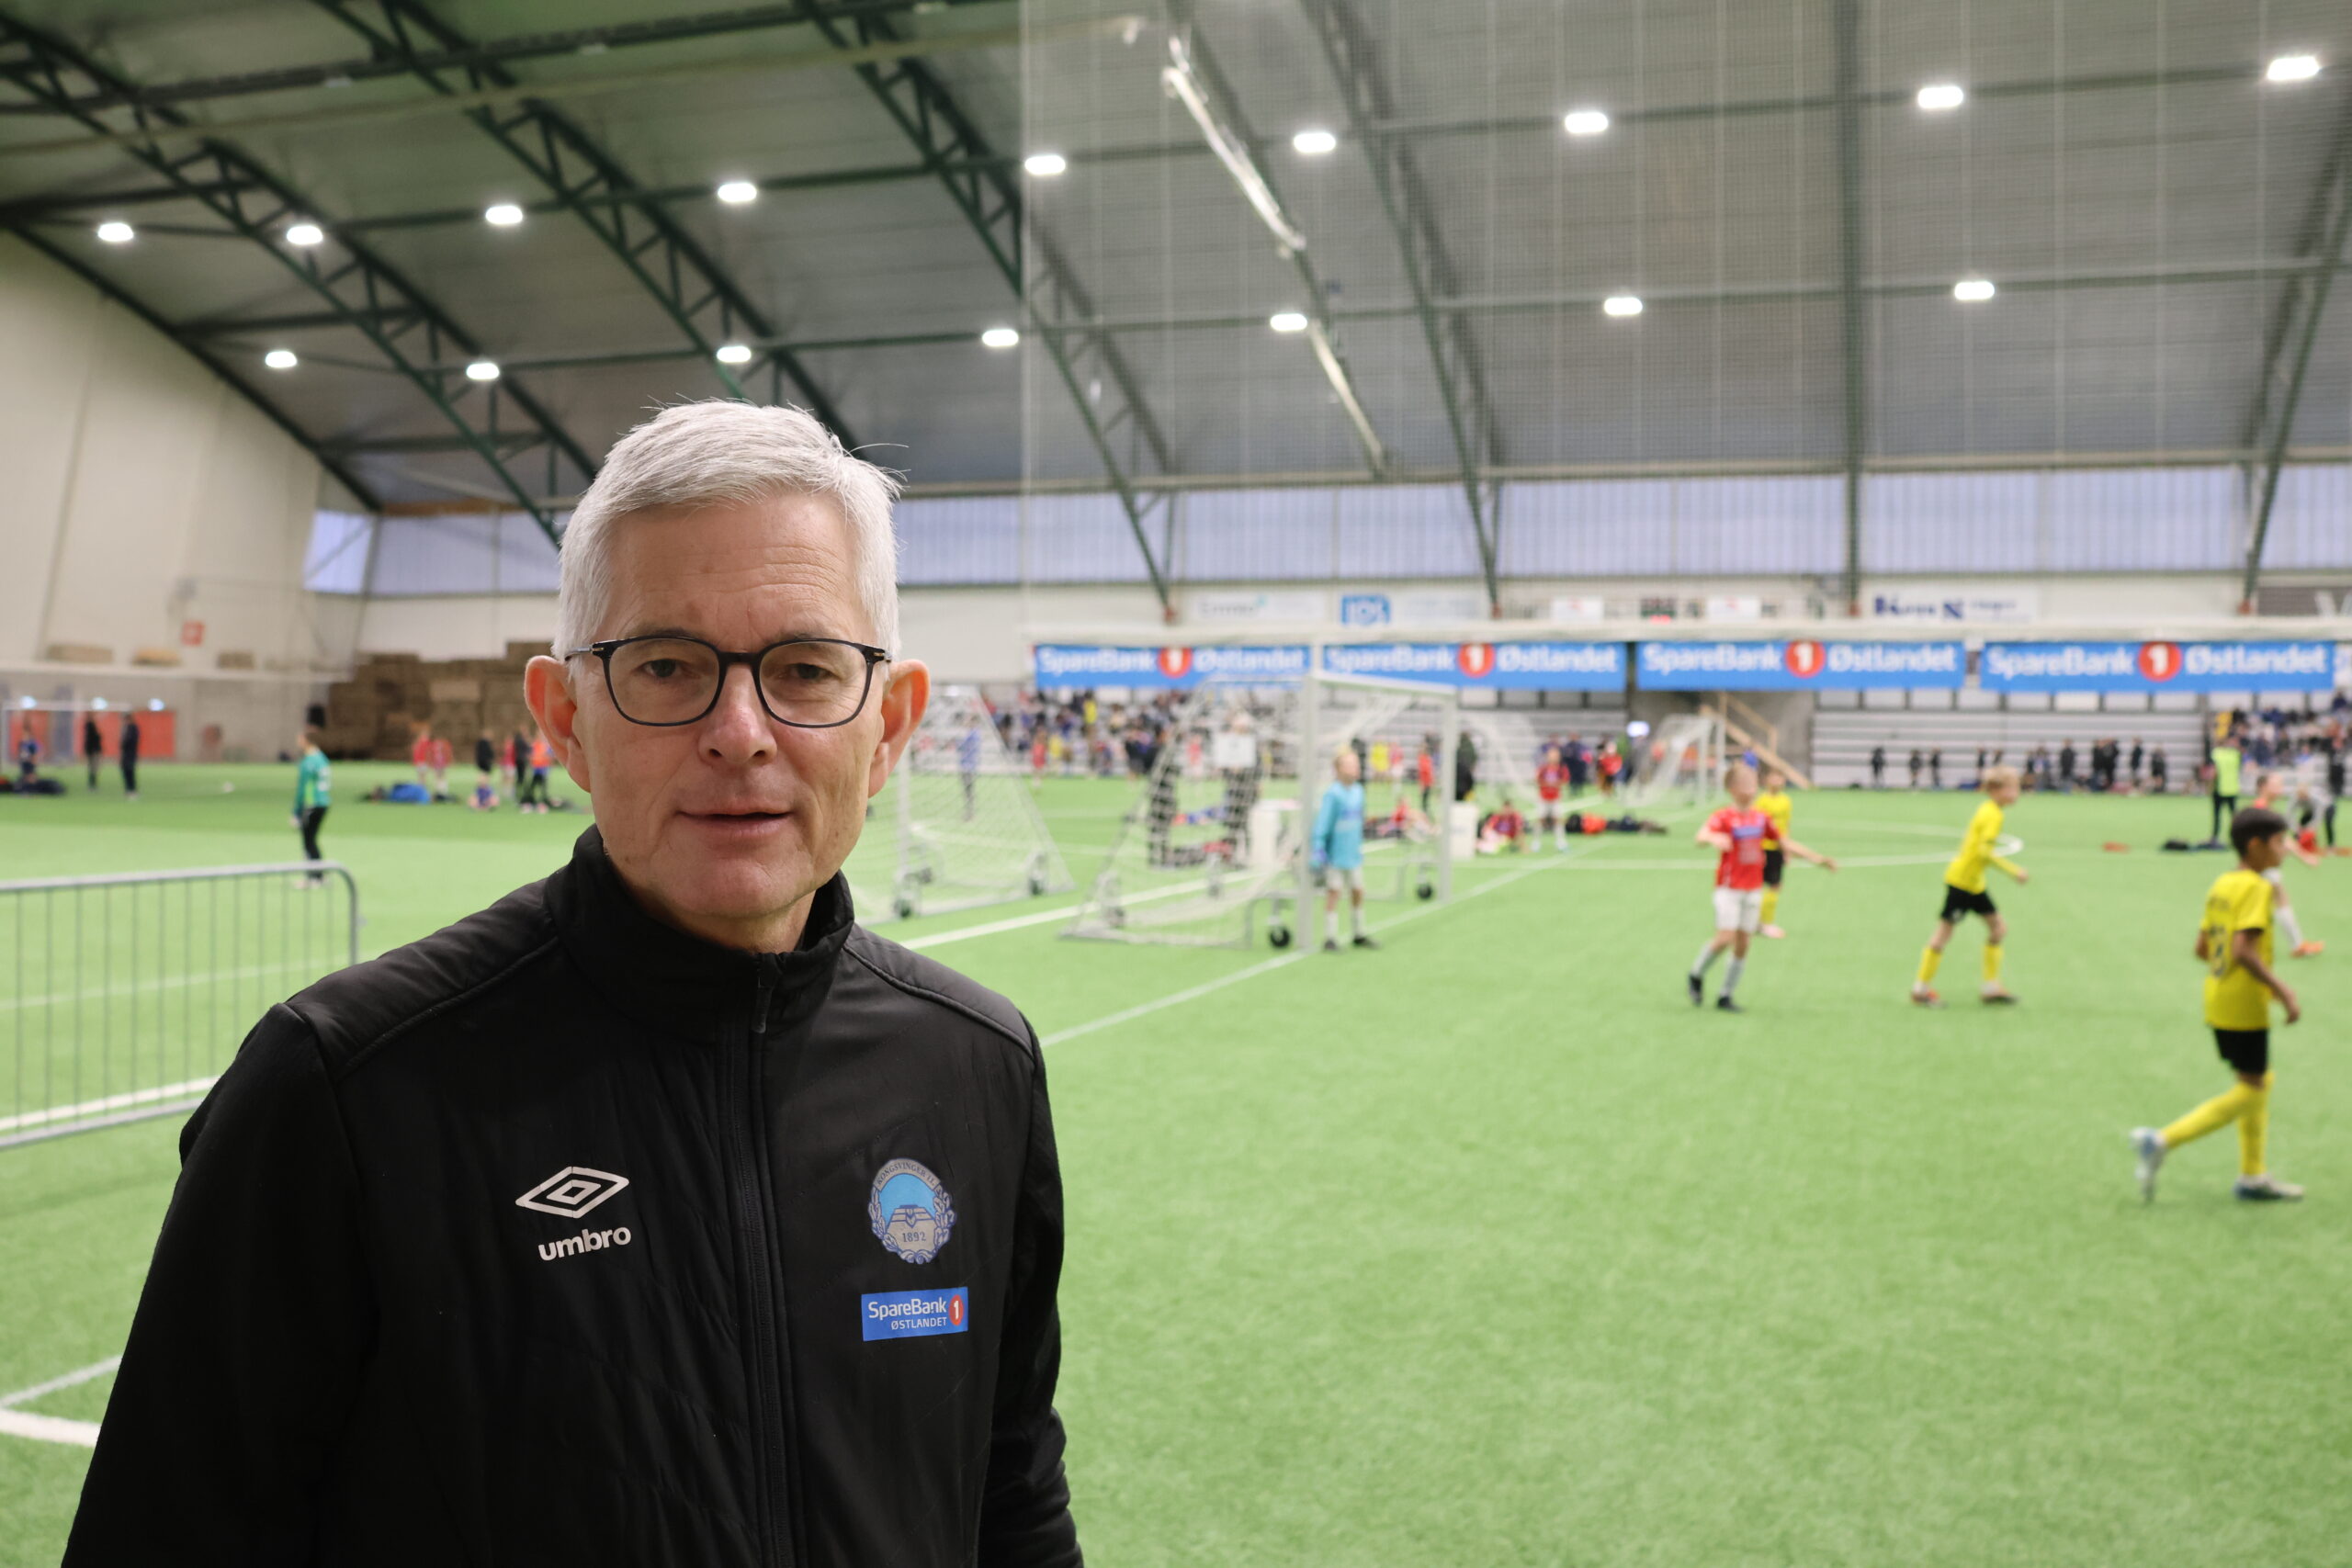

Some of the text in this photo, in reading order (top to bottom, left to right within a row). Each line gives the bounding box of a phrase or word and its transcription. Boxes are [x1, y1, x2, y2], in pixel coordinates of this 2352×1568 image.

[1039, 646, 1157, 675] SpareBank
[1166, 645, 1184, 672] 1
[1328, 644, 1619, 673] SpareBank 1 Østlandet
[1644, 643, 1956, 675] SpareBank 1 Østlandet
[1987, 644, 2326, 679] SpareBank 1 Østlandet
[538, 1227, 631, 1261] umbro
[901, 1232, 927, 1243] 1892
[867, 1297, 947, 1321] SpareBank
[890, 1316, 947, 1330] ØSTLANDET
